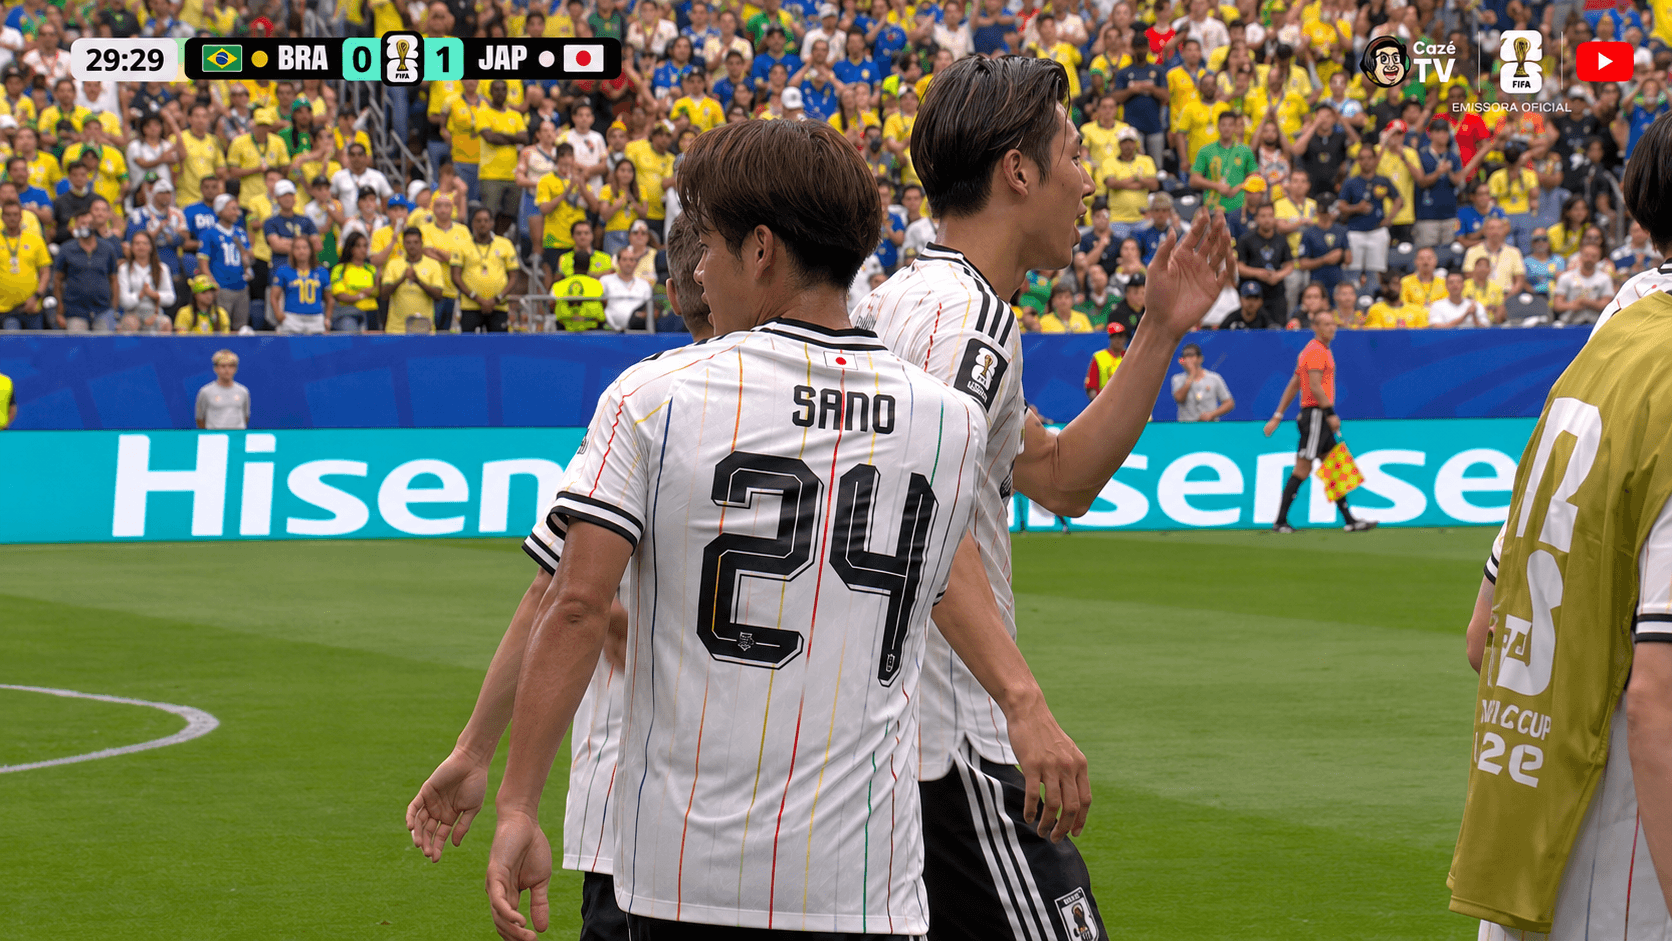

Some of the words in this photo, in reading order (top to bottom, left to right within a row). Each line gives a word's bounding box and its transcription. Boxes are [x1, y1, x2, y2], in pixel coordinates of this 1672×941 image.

[221, 242, 241, 267] 10
[292, 279, 317, 304] 10
[792, 385, 896, 435] SANO
[697, 451, 940, 687] 24
